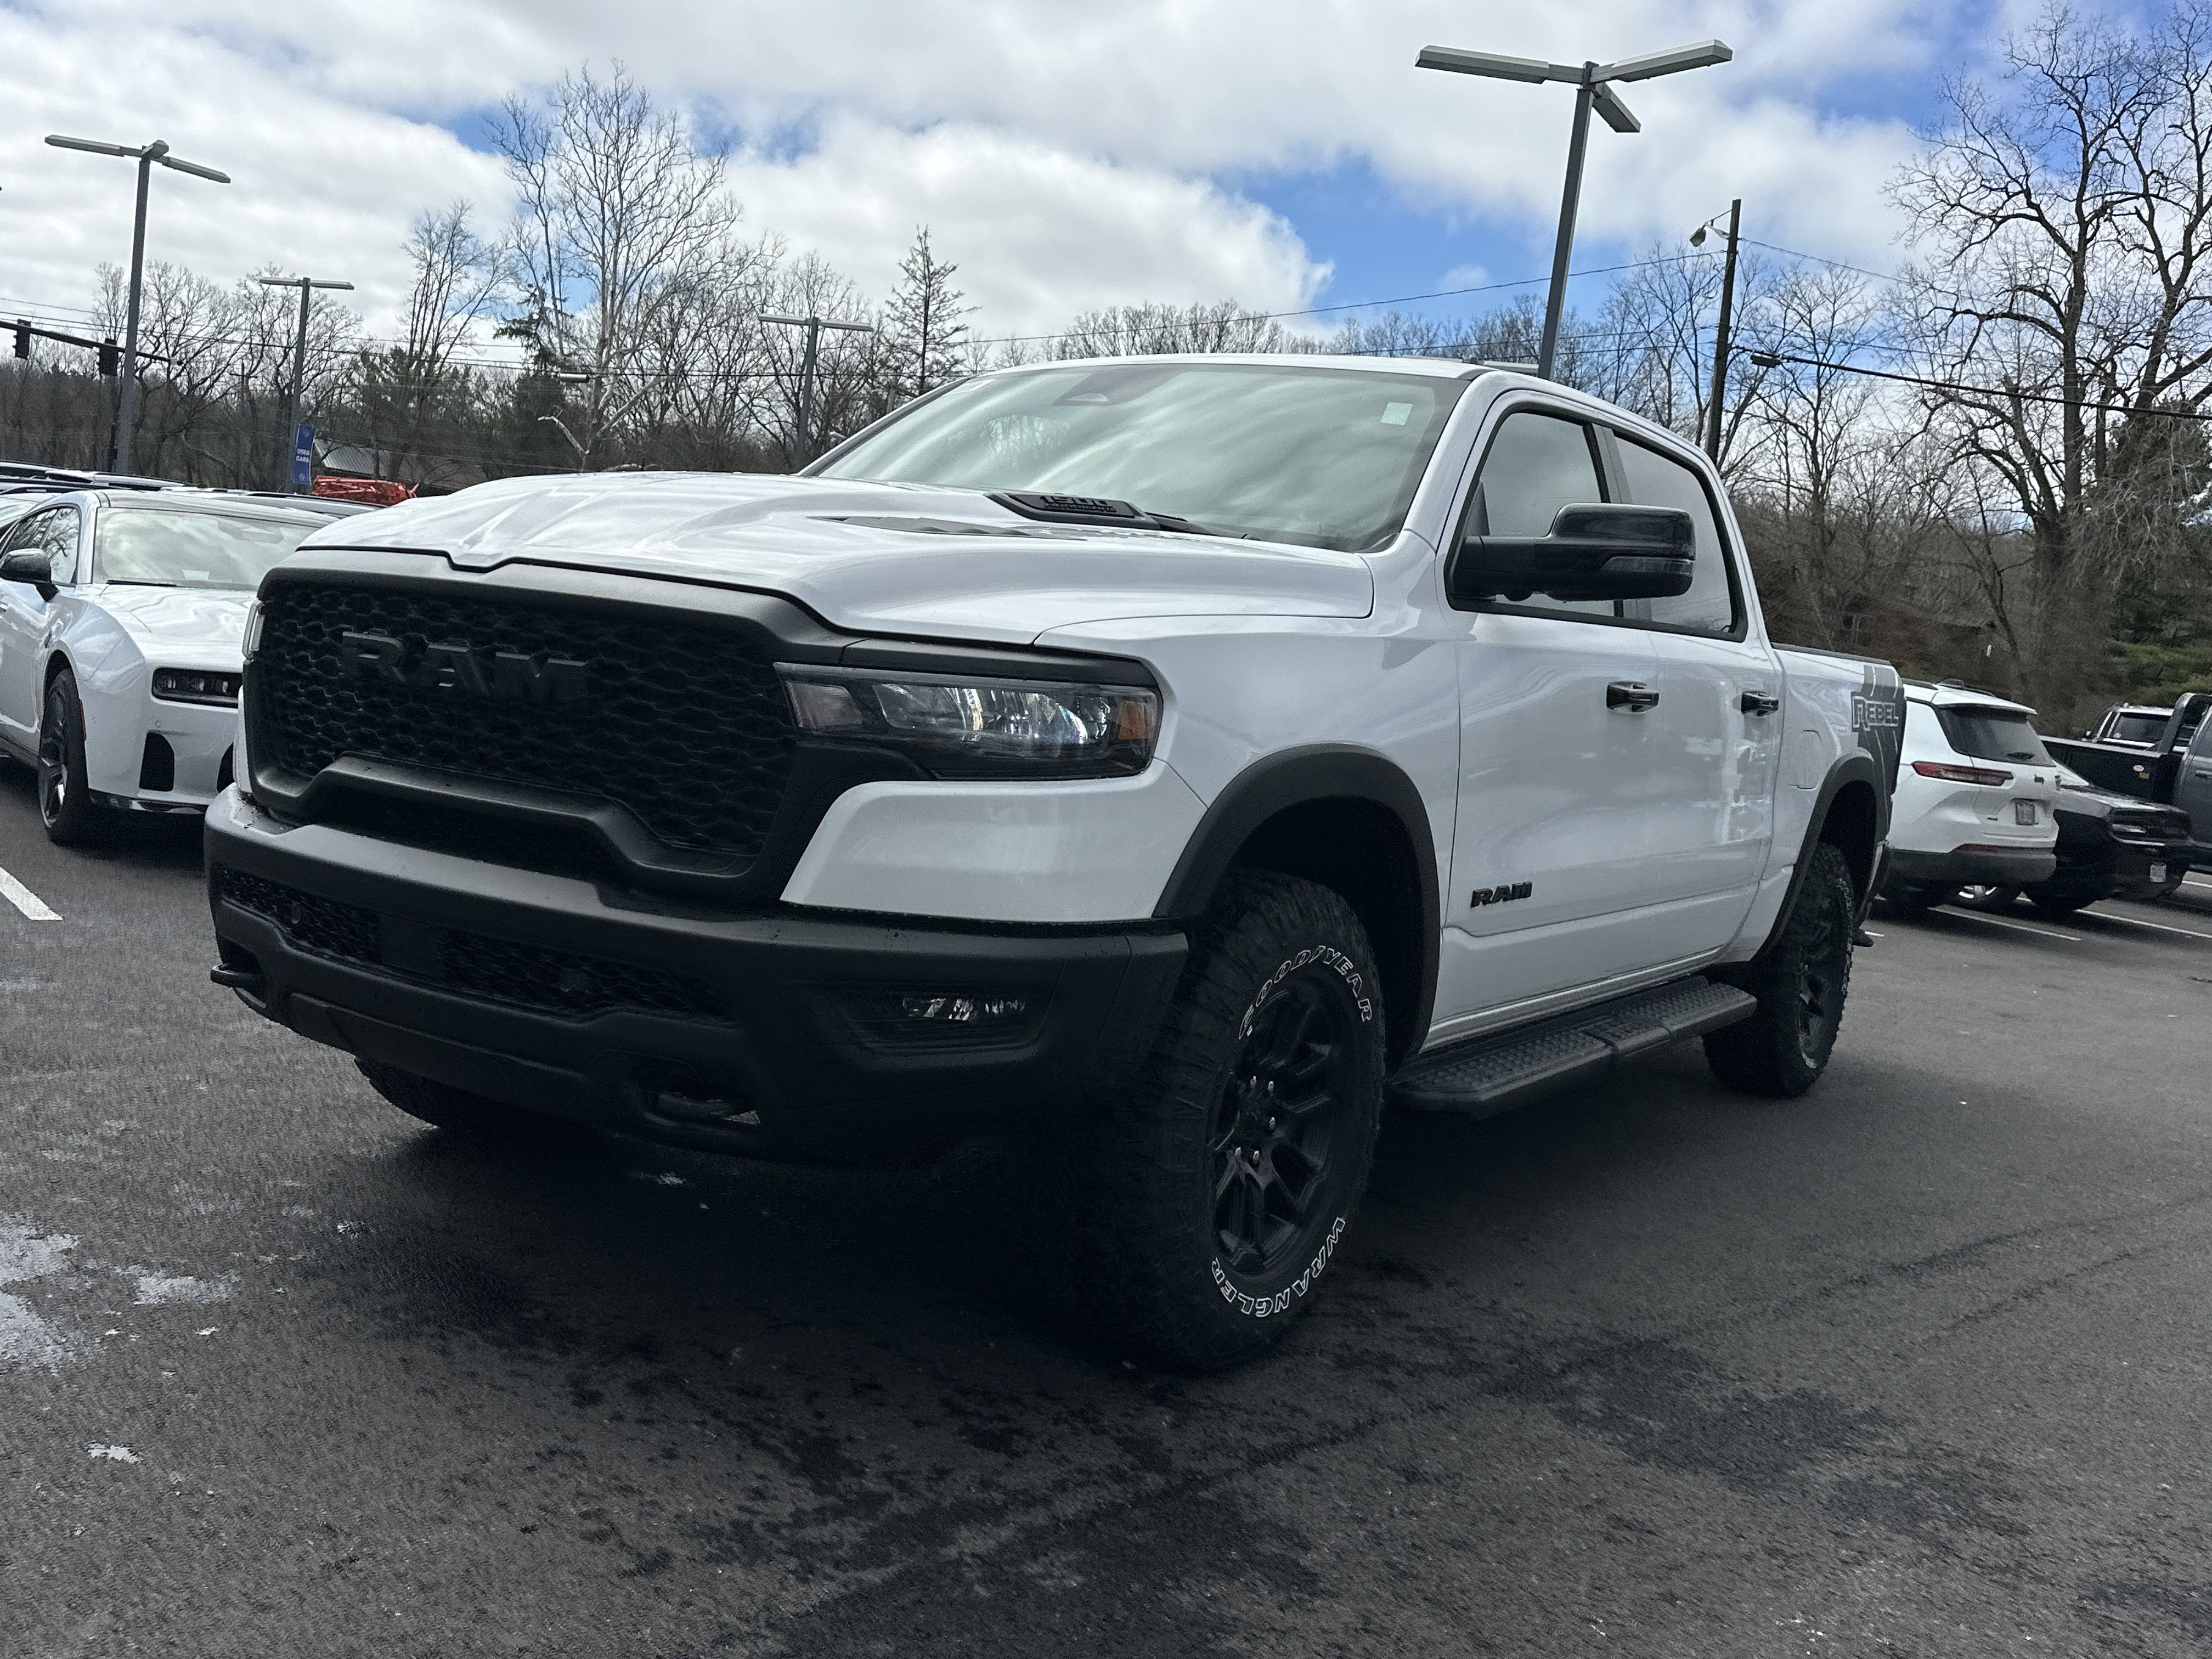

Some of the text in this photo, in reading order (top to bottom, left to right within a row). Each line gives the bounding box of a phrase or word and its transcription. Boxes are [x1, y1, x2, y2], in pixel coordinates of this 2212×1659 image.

[342, 631, 589, 701] RAM
[1852, 695, 1899, 731] REBEL
[1470, 881, 1533, 909] RAM
[1238, 945, 1373, 1040] GOODYEAR
[1211, 1216, 1346, 1318] WRANGLER
